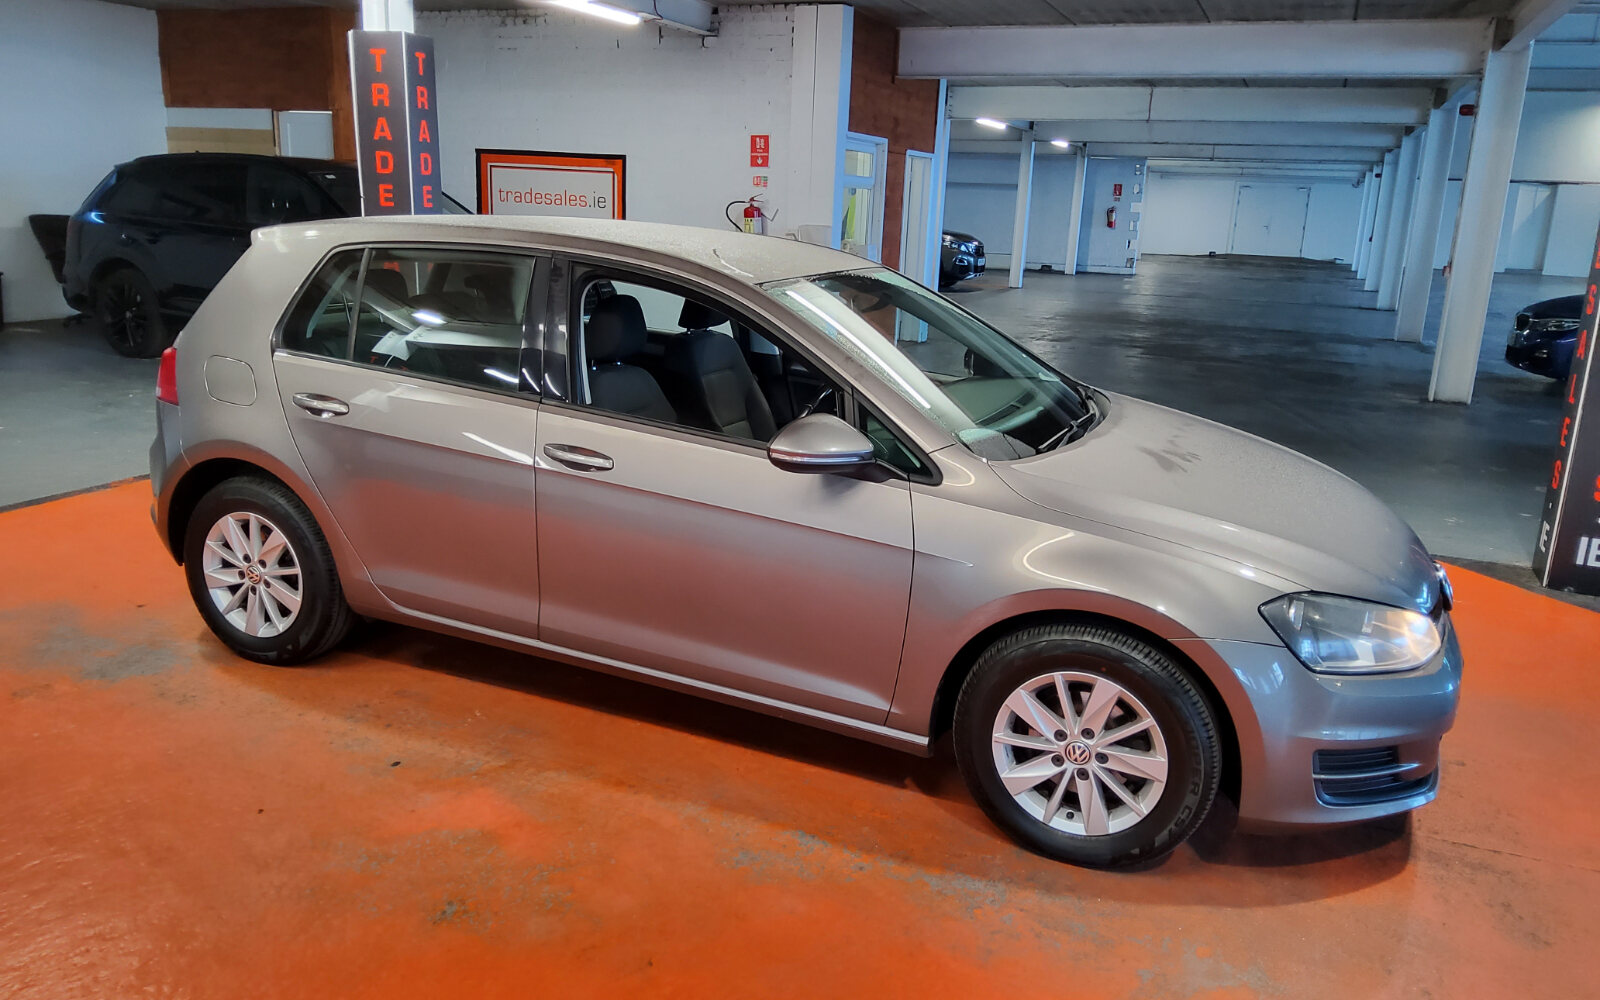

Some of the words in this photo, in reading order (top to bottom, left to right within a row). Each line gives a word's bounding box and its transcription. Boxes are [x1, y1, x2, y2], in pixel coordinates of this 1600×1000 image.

[369, 48, 395, 207] TRADE
[414, 51, 433, 208] TRADE
[498, 187, 607, 209] tradesales.ie
[1552, 284, 1597, 490] SALES
